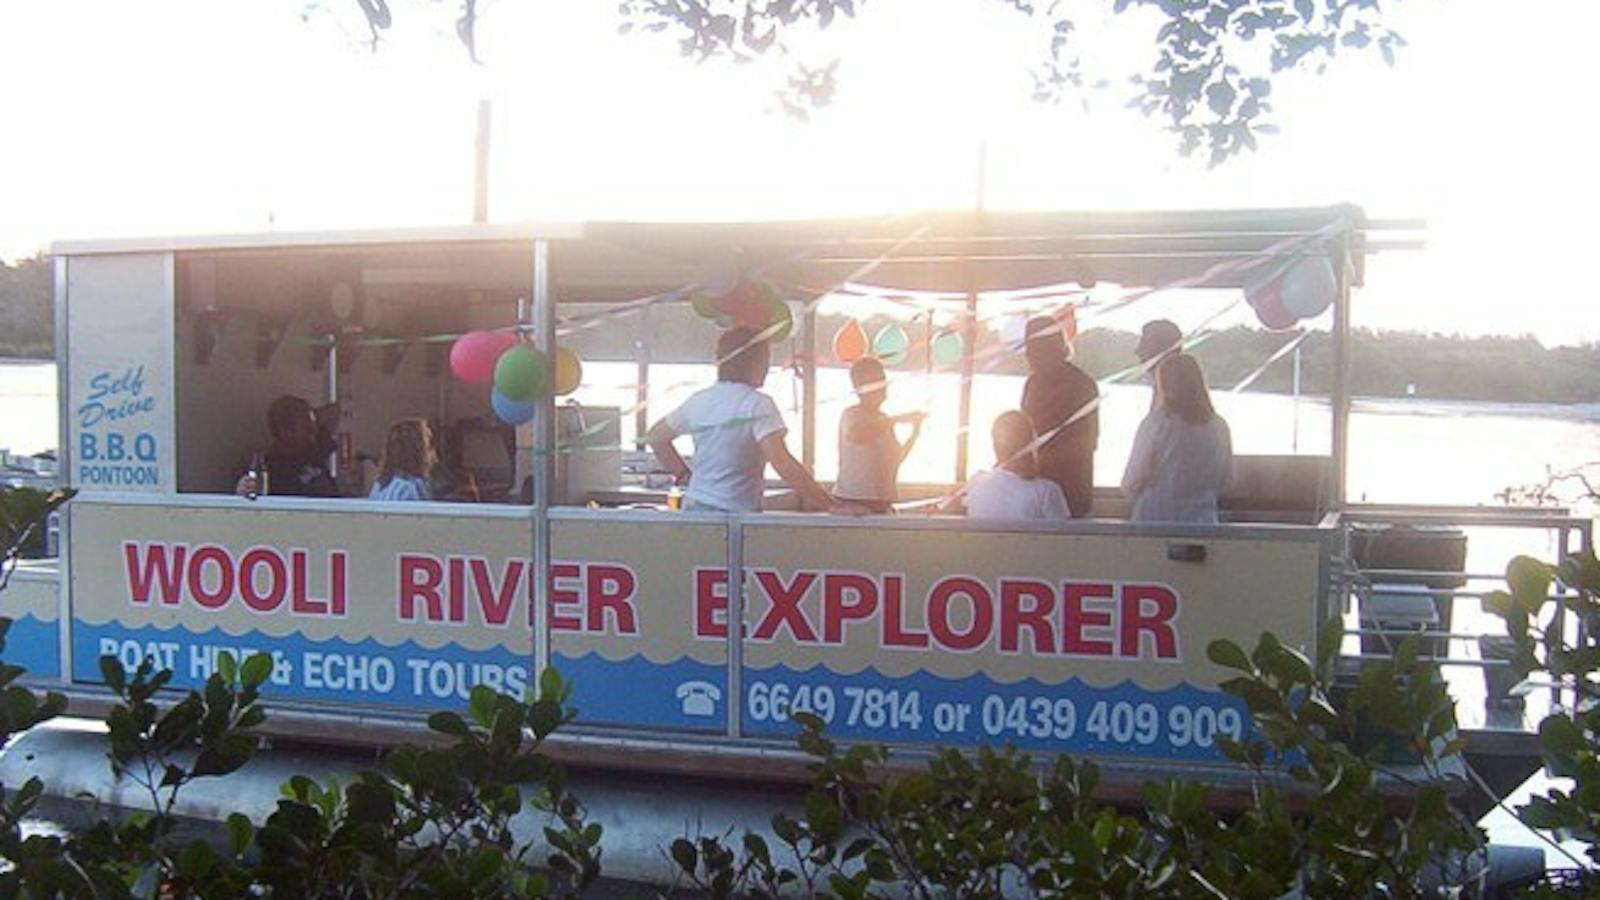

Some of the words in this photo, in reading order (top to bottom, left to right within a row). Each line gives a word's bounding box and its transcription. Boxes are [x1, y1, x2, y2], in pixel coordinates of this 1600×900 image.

[87, 364, 144, 400] Self
[78, 396, 154, 428] Drive
[80, 432, 157, 462] B.B.Q
[79, 466, 158, 485] PONTOON
[123, 541, 347, 617] WOOLI
[398, 553, 639, 635] RIVER
[694, 567, 1179, 660] EXPLORER
[271, 650, 293, 685] &
[303, 652, 396, 693] ECHO
[406, 659, 527, 703] TOURS
[747, 681, 836, 725] 6649
[843, 687, 923, 730] 7814
[933, 702, 972, 733] or
[982, 694, 1077, 740] 0439
[1086, 701, 1159, 745] 409
[1168, 705, 1242, 747] 909
